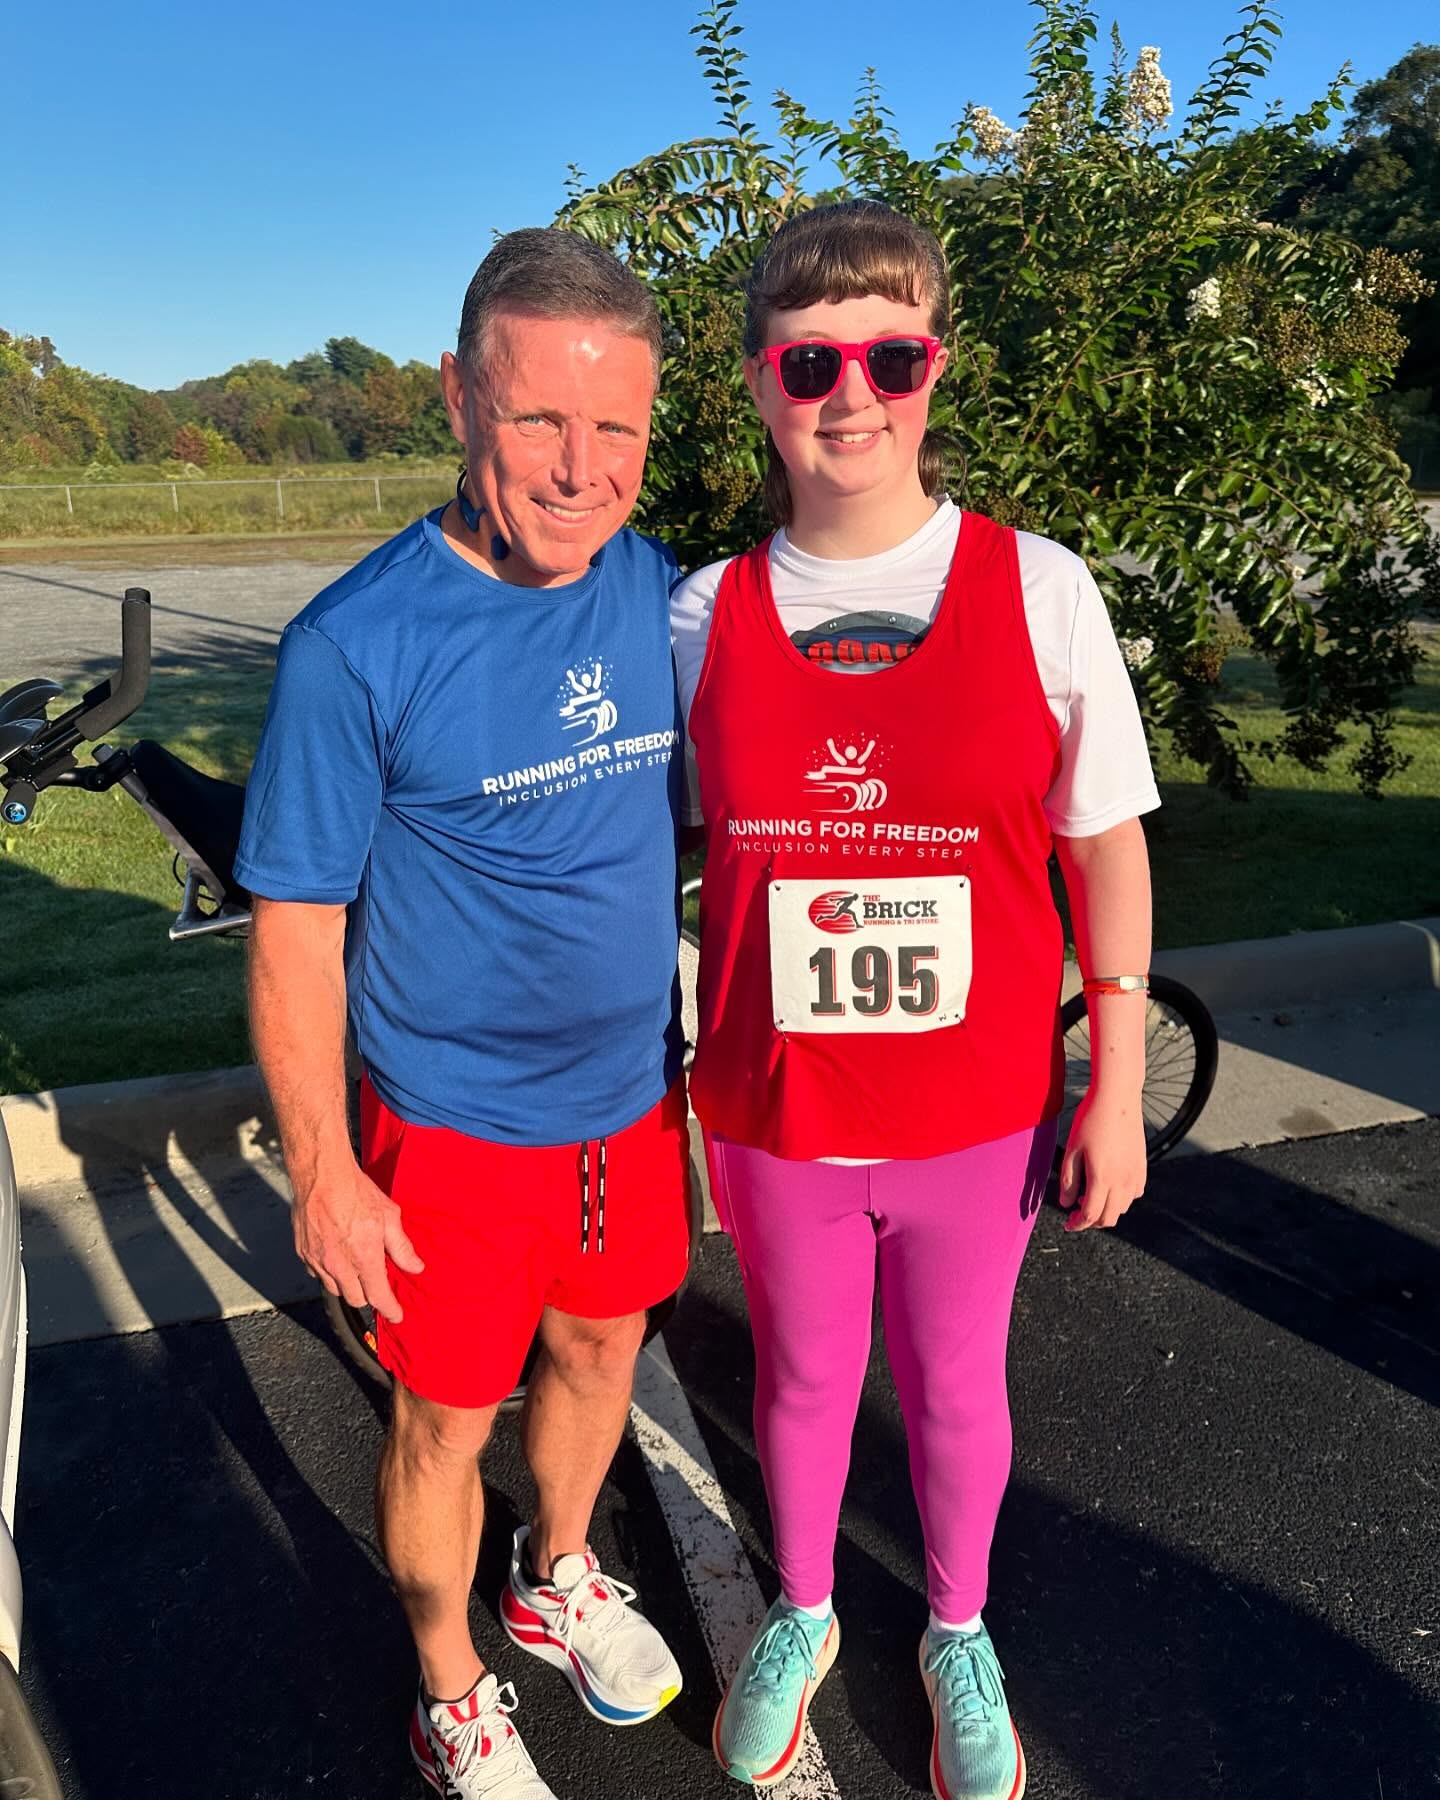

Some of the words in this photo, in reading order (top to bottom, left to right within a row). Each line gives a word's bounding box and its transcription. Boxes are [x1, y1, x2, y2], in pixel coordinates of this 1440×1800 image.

[481, 756, 576, 795] RUNNING
[578, 744, 611, 769] FOR
[499, 774, 587, 807] INCLUSION
[594, 759, 641, 780] EVERY
[728, 819, 812, 836] RUNNING
[819, 820, 866, 839] FOR
[873, 823, 979, 844] FREEDOM
[736, 841, 830, 854] INCLUSION
[842, 844, 905, 857] EVERY
[917, 847, 963, 859] STEP
[863, 900, 938, 919] BRICK
[809, 945, 940, 1017] 195
